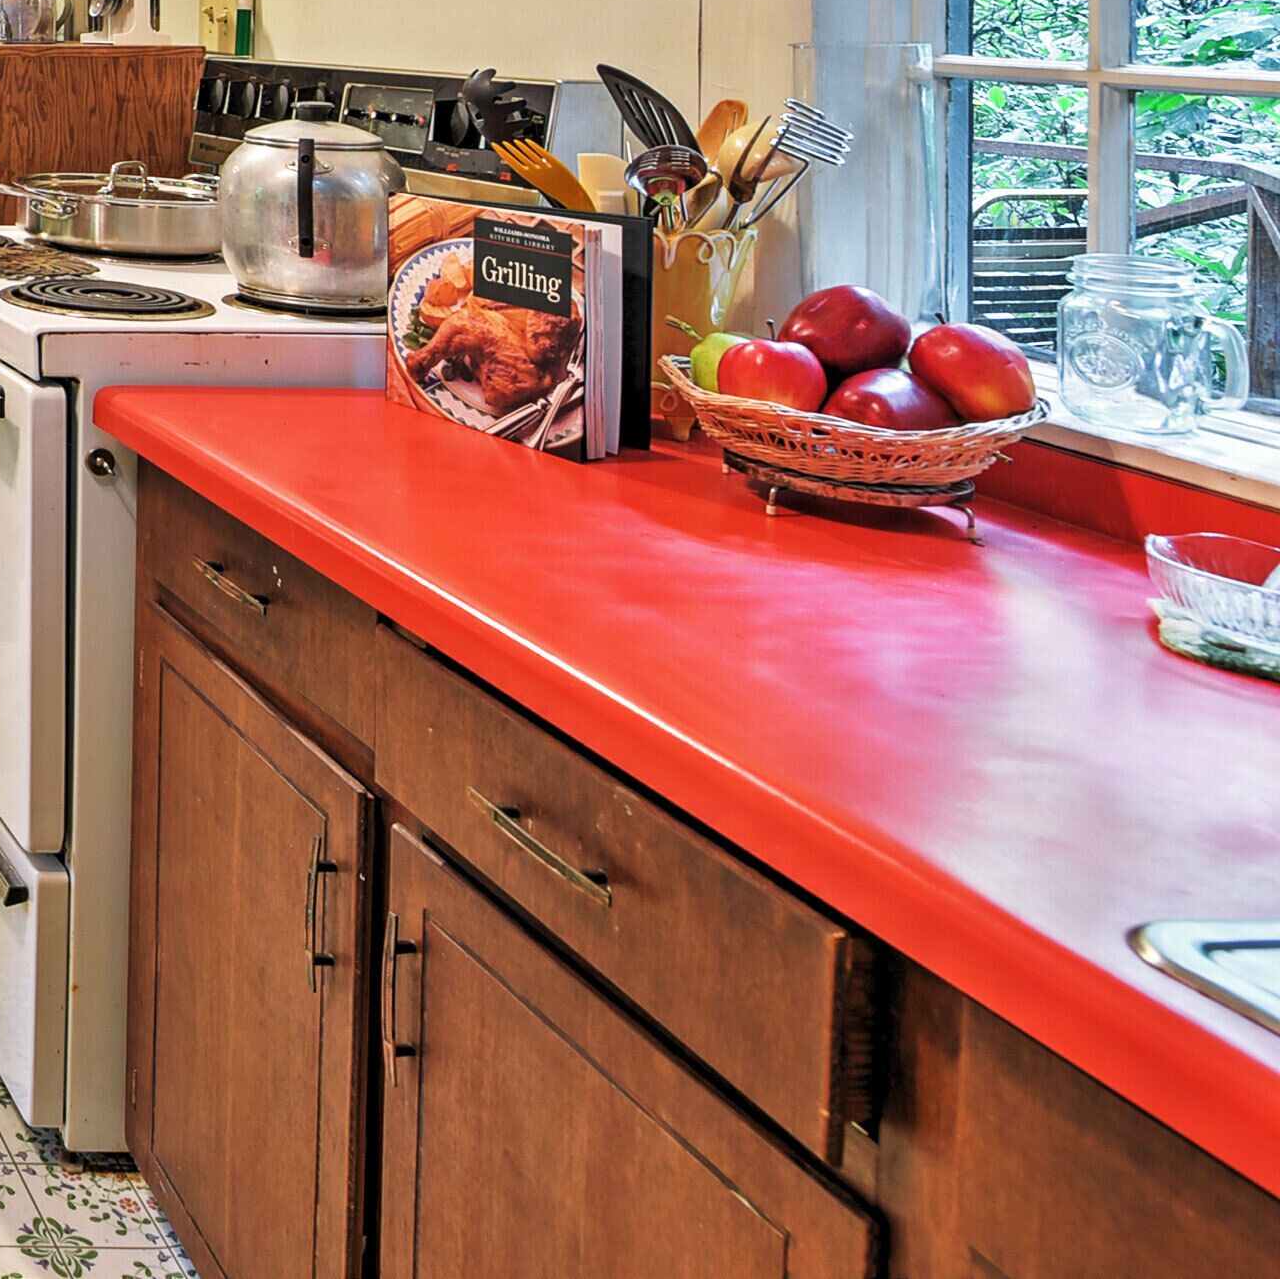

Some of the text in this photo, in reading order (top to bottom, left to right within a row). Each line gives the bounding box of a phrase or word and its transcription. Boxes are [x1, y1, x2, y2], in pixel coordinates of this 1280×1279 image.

[489, 233, 556, 252] KITCHEN LIBRARY
[493, 226, 551, 243] WILLIAMS-SONOMA
[481, 255, 563, 304] Grilling
